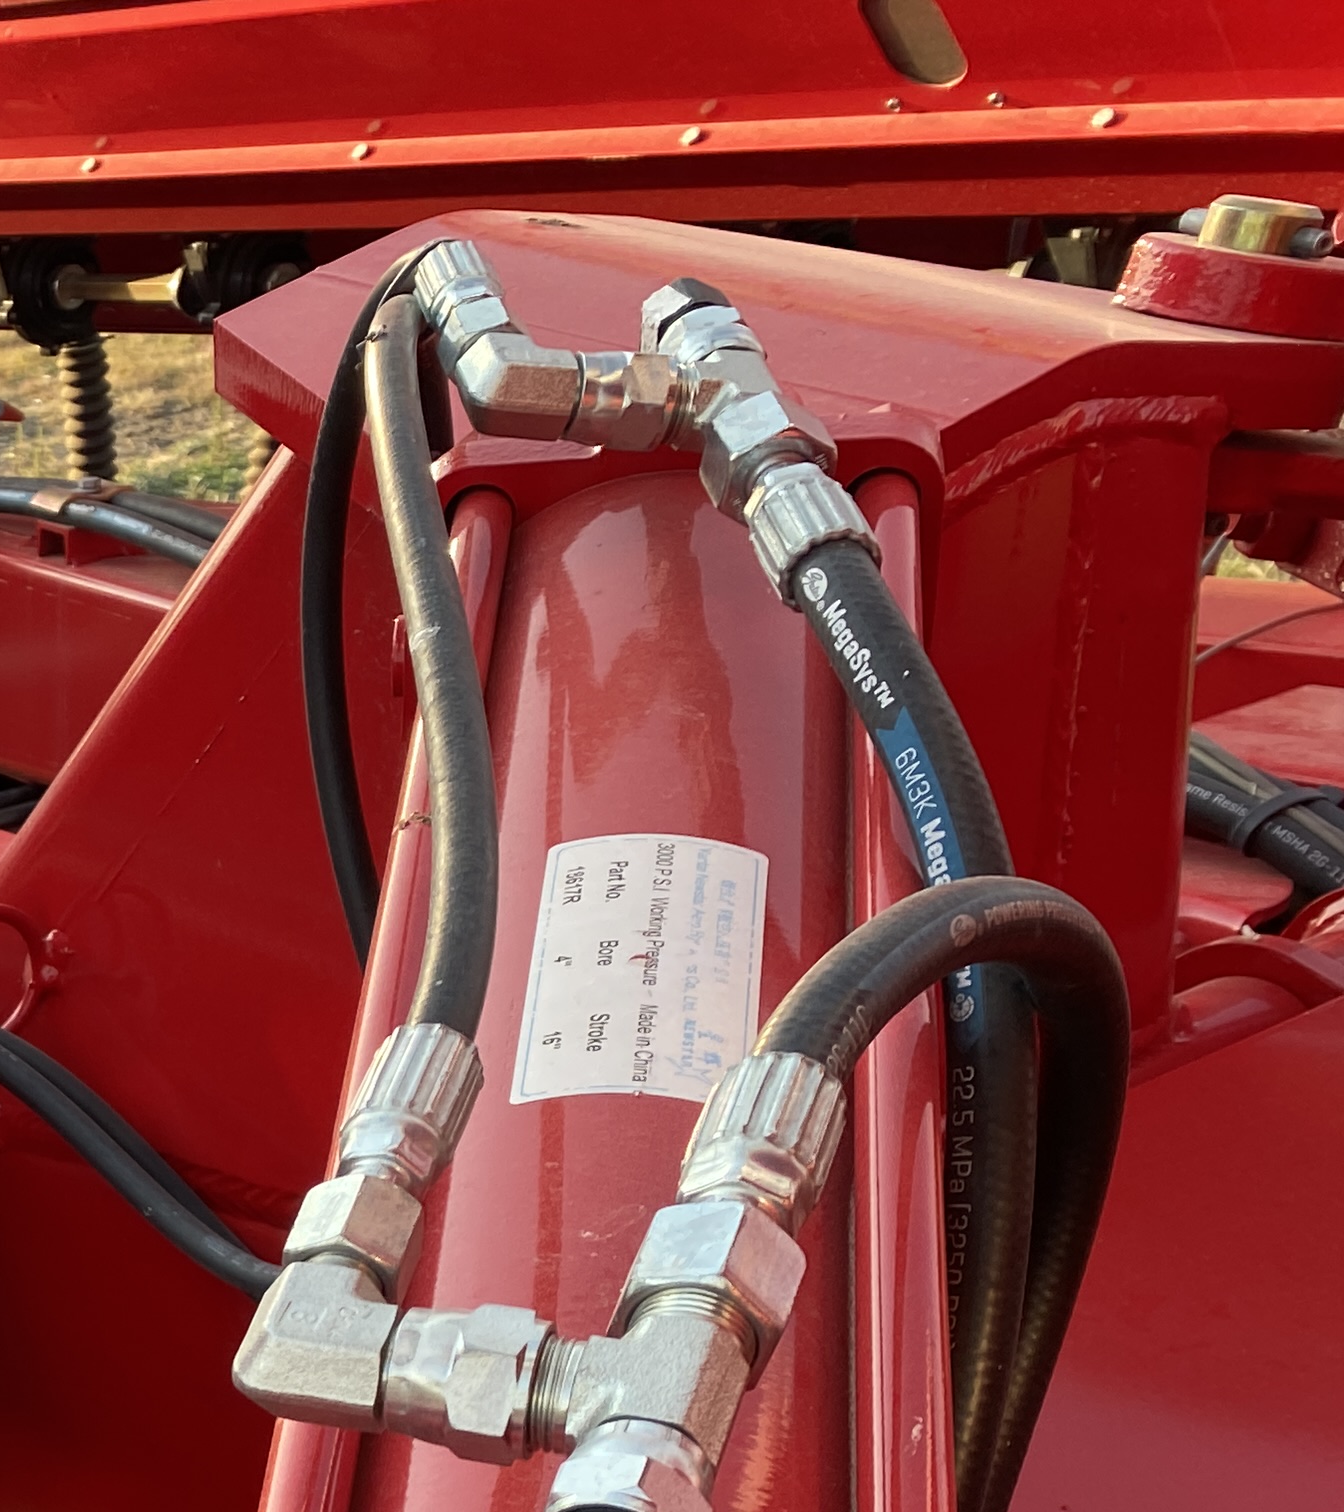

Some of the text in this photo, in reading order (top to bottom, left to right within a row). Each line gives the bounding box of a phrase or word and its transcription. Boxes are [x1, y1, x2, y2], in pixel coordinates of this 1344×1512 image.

[895, 747, 937, 820] 6M3K
[656, 843, 676, 867] 3000
[1272, 825, 1311, 855] MSHA
[642, 897, 670, 938] Working
[586, 861, 629, 1052] Part No. Bore Stroke
[642, 940, 664, 986] Pressure
[637, 1004, 659, 1034] Made
[542, 1031, 562, 1049] 16"
[636, 1036, 654, 1048] in
[632, 1050, 654, 1083] China
[952, 1065, 975, 1126] 22.5
[949, 1136, 973, 1193] MPa
